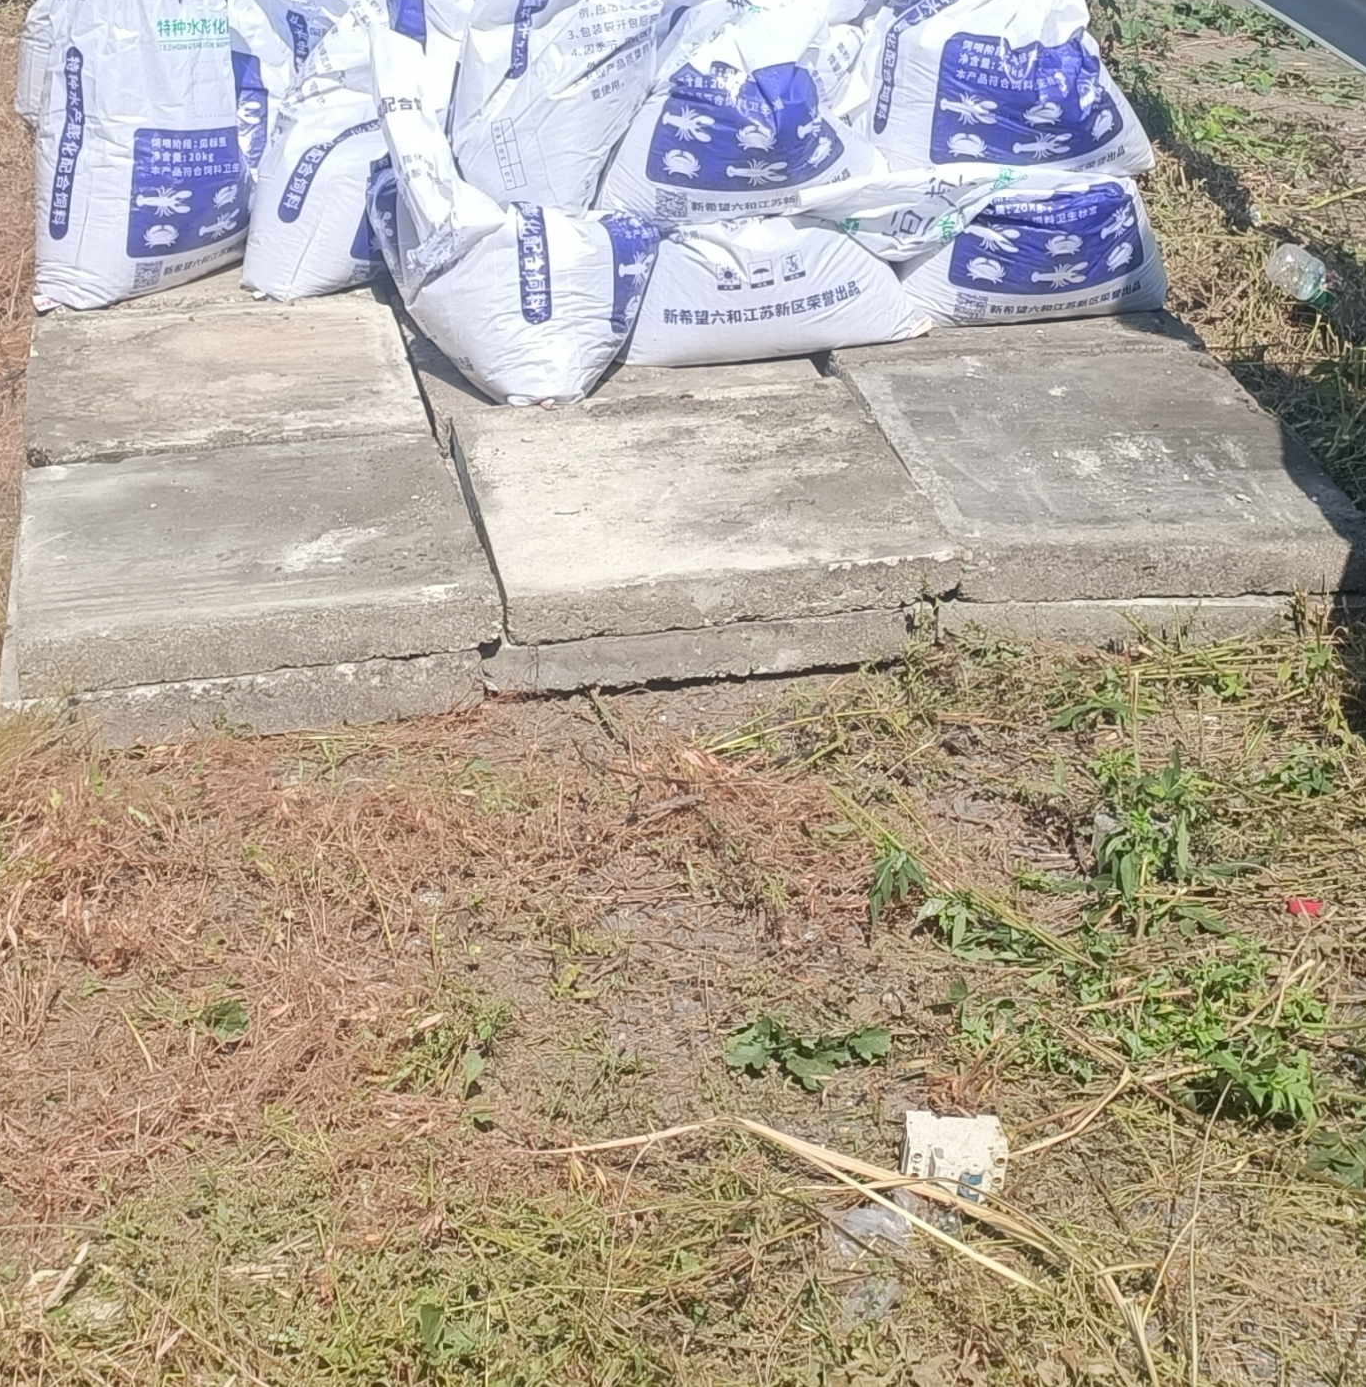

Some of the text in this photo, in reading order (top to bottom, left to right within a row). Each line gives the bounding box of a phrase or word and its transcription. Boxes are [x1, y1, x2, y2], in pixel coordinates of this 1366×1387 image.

[663, 280, 862, 325] 新希望六和江苏新区荣誉出品
[990, 280, 1141, 314] 新希望六和江苏新区荣誉出品
